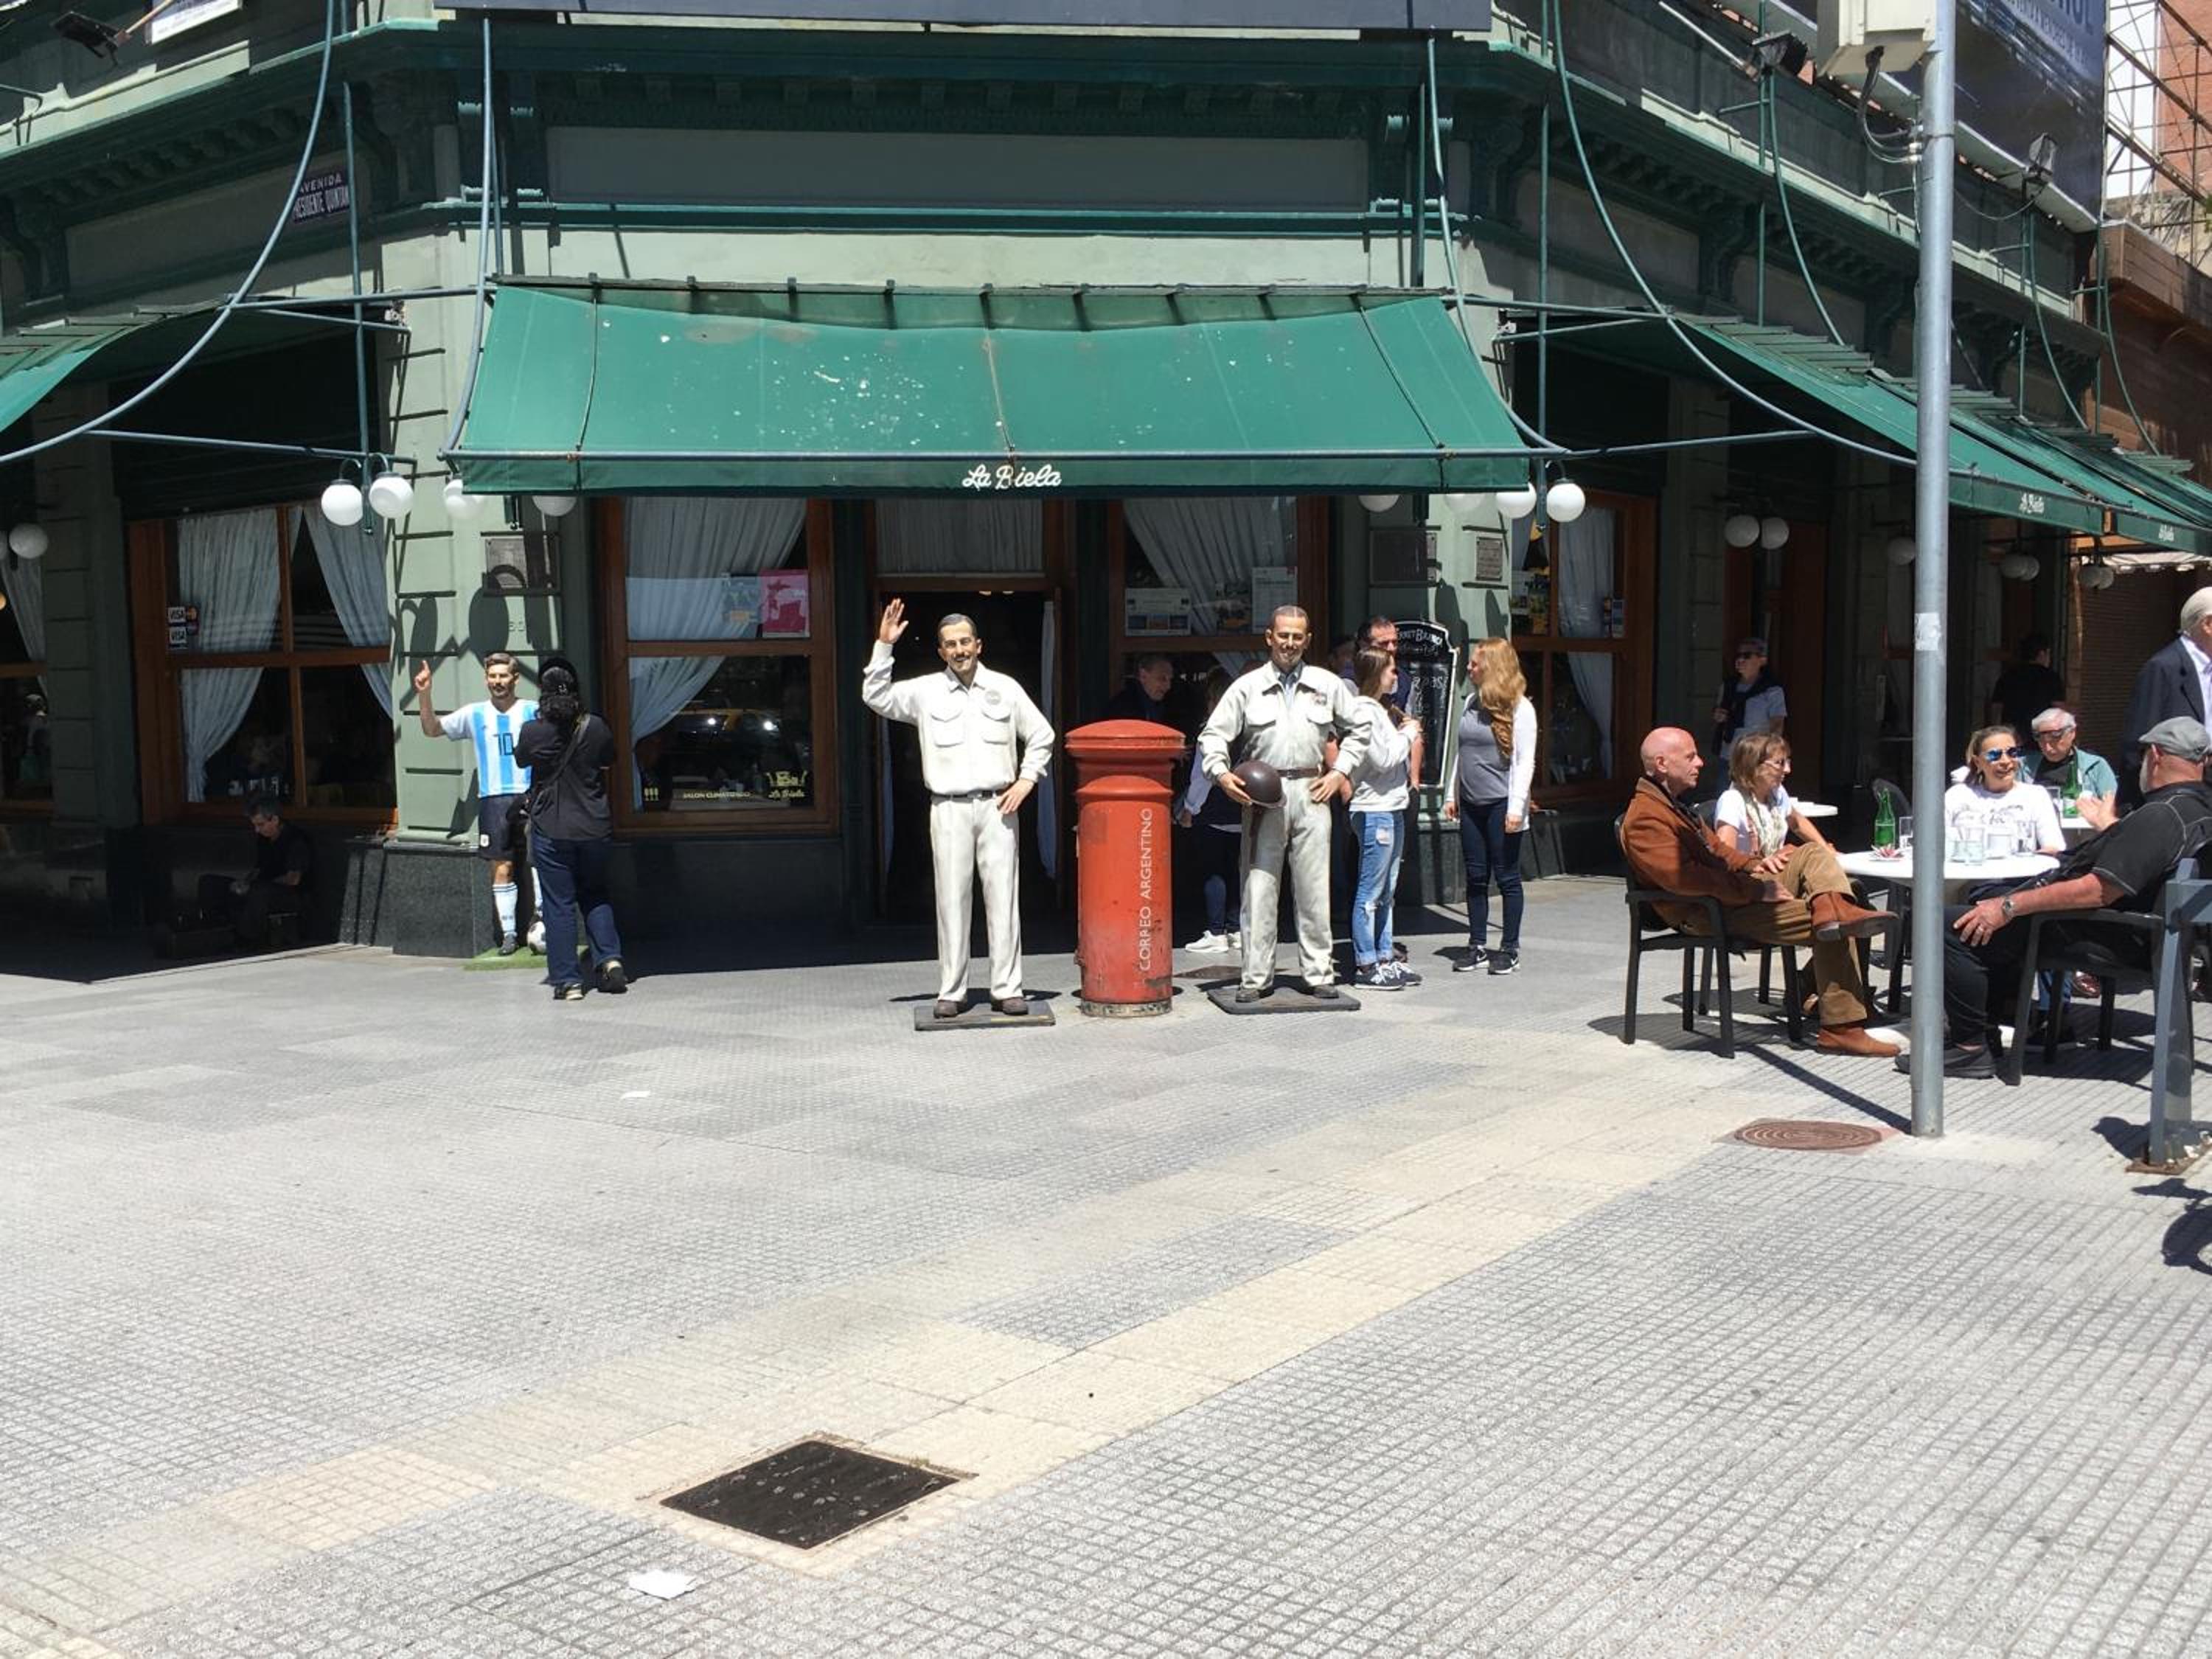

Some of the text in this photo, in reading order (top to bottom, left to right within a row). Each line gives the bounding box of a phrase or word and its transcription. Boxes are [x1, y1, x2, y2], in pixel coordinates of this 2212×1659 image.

[961, 464, 1062, 491] La Biela
[493, 733, 514, 756] 10
[1139, 807, 1152, 971] CORREO ARGENTINO
